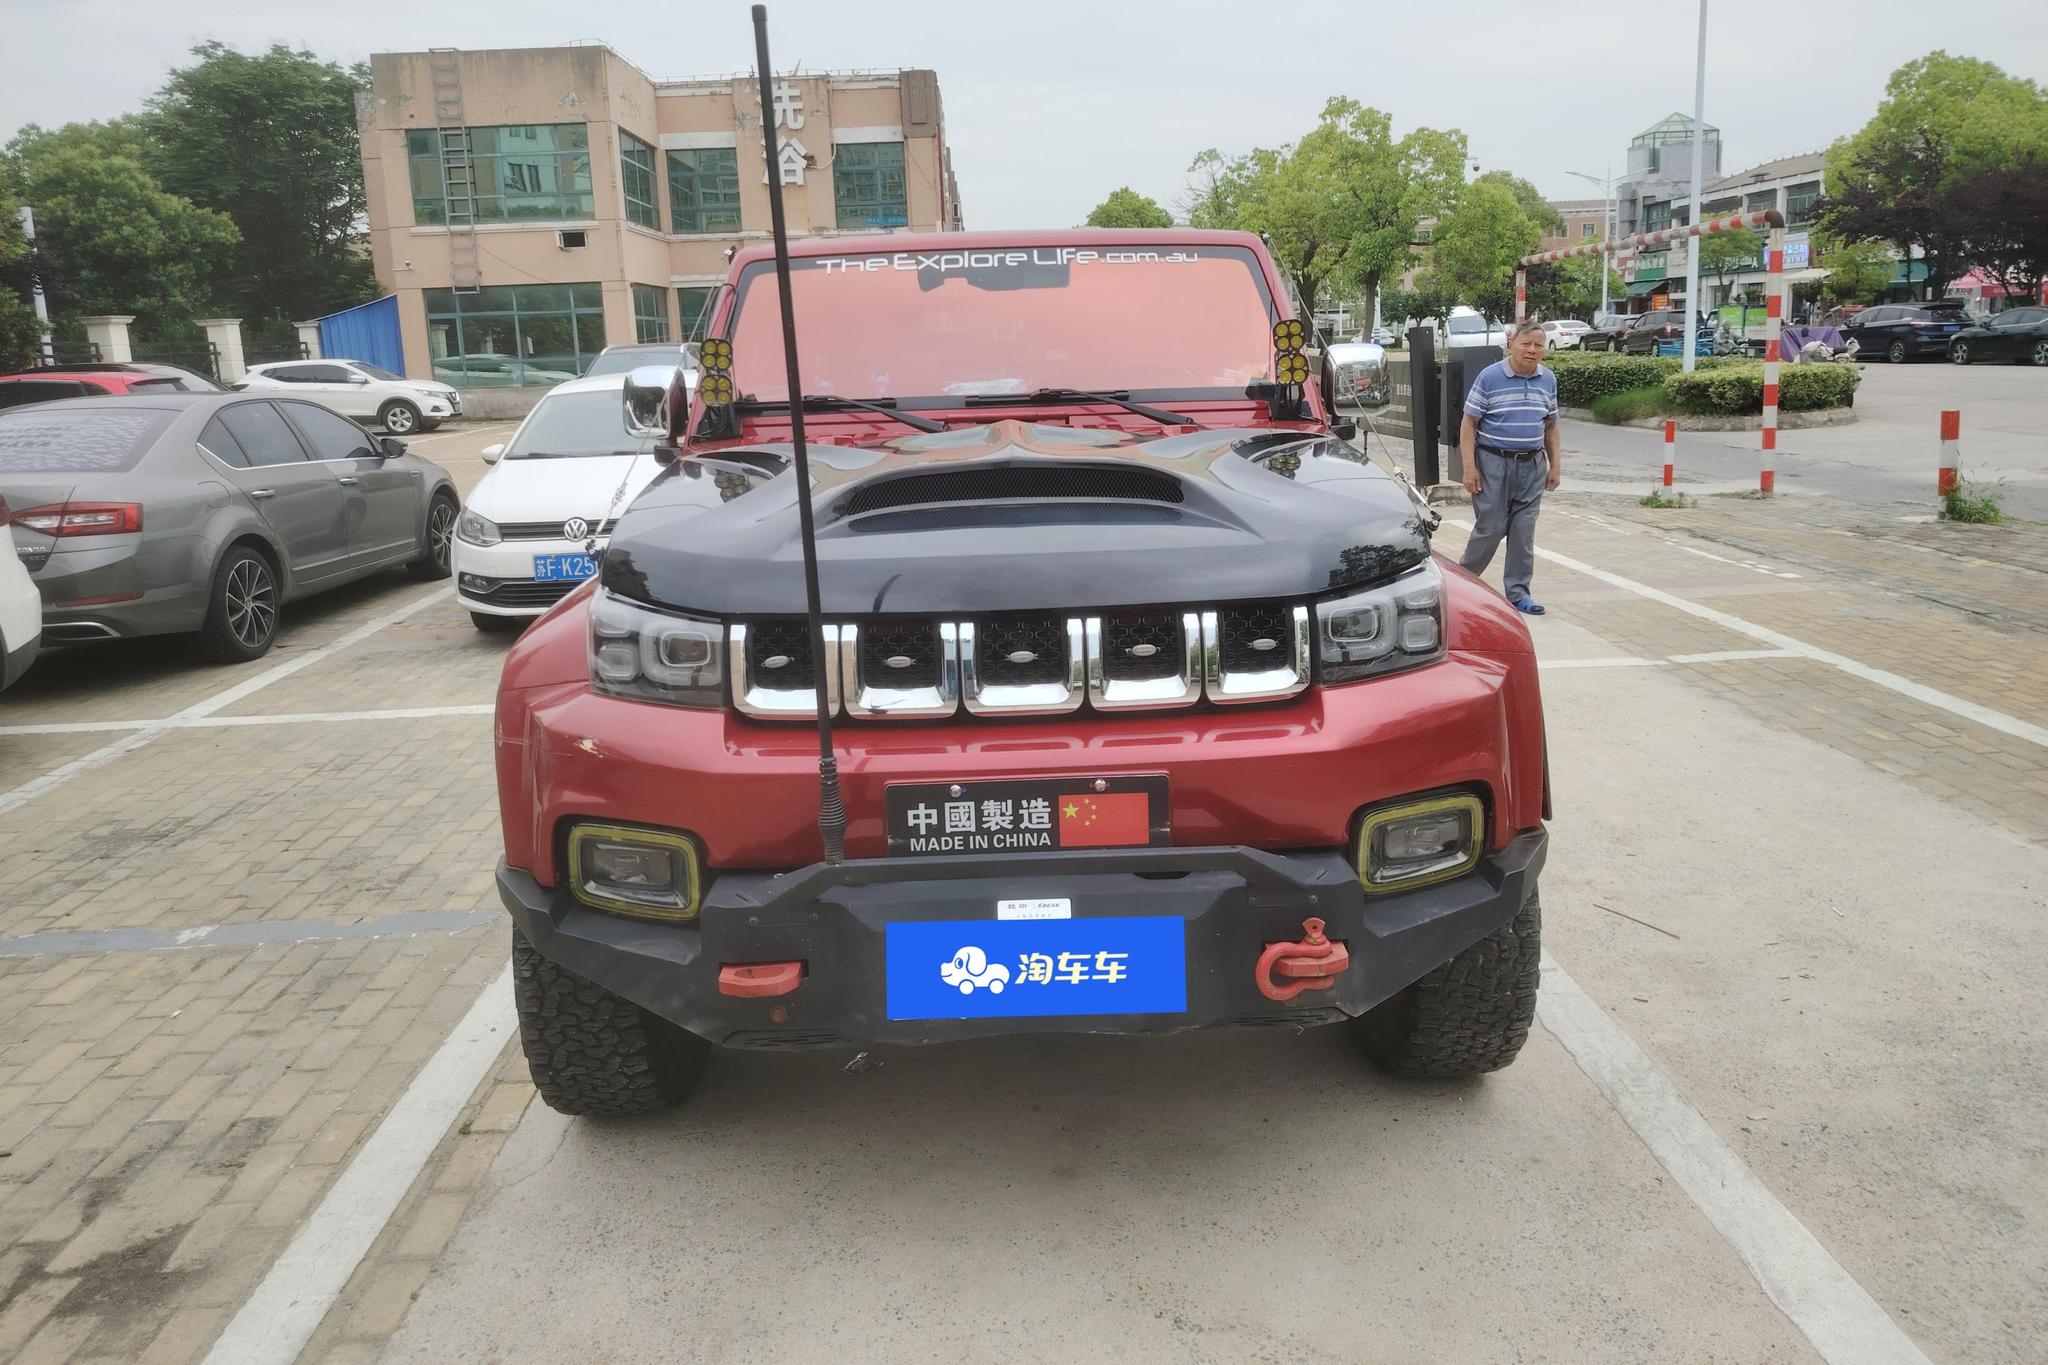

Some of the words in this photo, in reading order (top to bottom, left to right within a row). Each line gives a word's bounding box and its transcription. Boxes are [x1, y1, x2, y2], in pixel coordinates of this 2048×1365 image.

[756, 80, 809, 186] 洗浴
[816, 257, 889, 274] The
[893, 251, 1028, 272] Explore
[907, 798, 1052, 835] 中國製造
[910, 836, 964, 851] MADE
[969, 835, 988, 849] IN
[993, 832, 1052, 848] CHINA
